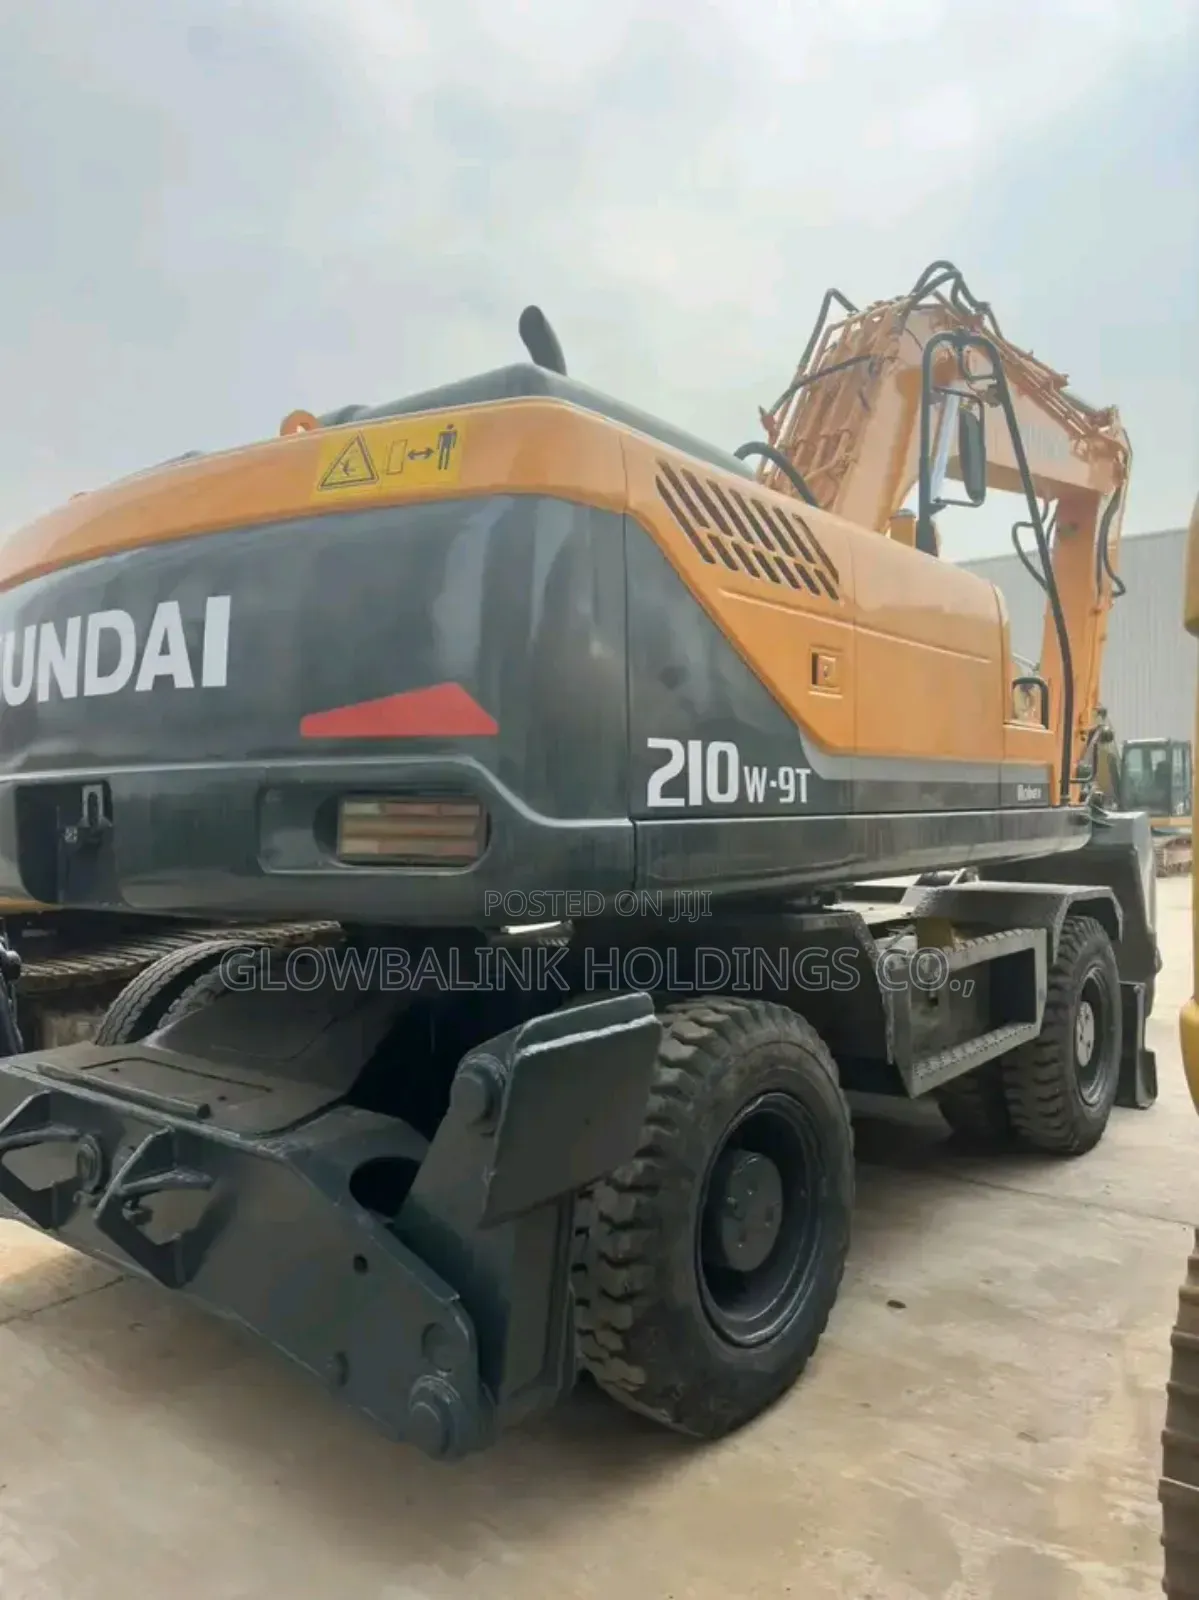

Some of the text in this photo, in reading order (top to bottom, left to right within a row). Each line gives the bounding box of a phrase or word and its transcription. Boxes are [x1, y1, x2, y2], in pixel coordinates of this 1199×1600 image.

[0, 595, 231, 706] UNDAI
[647, 737, 811, 807] 210 W-9T
